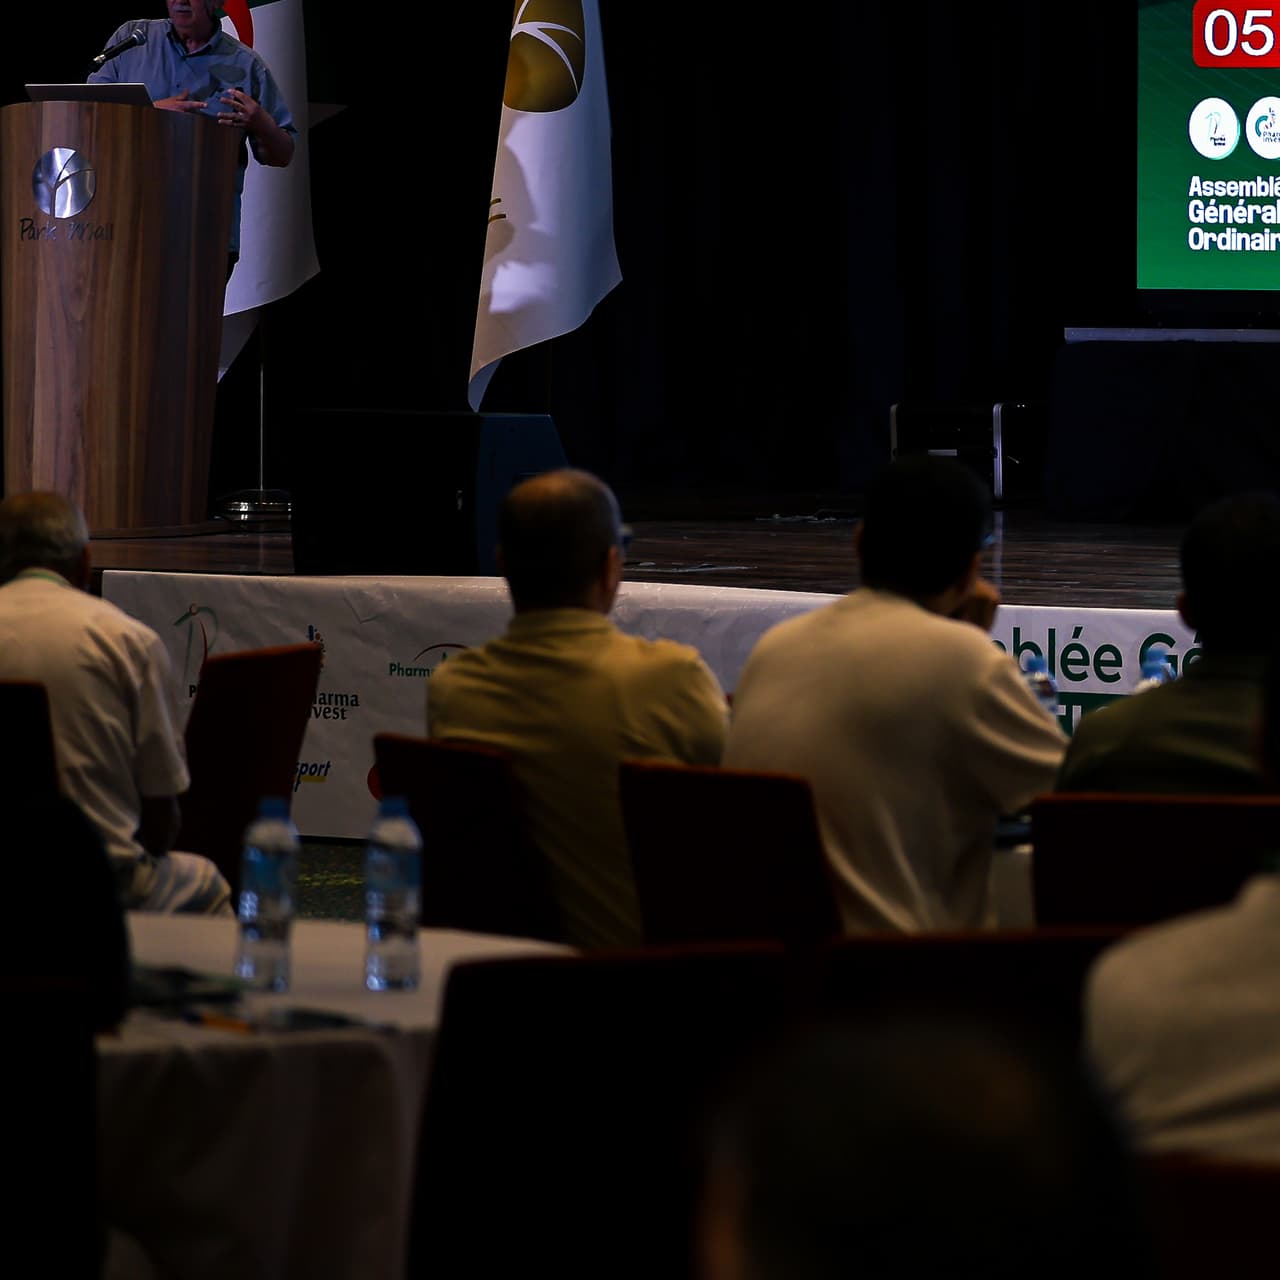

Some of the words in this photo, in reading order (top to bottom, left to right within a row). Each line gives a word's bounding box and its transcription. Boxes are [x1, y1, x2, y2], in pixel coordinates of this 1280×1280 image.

[20, 218, 57, 241] Park
[389, 662, 431, 678] Pharm
[313, 692, 360, 707] arma
